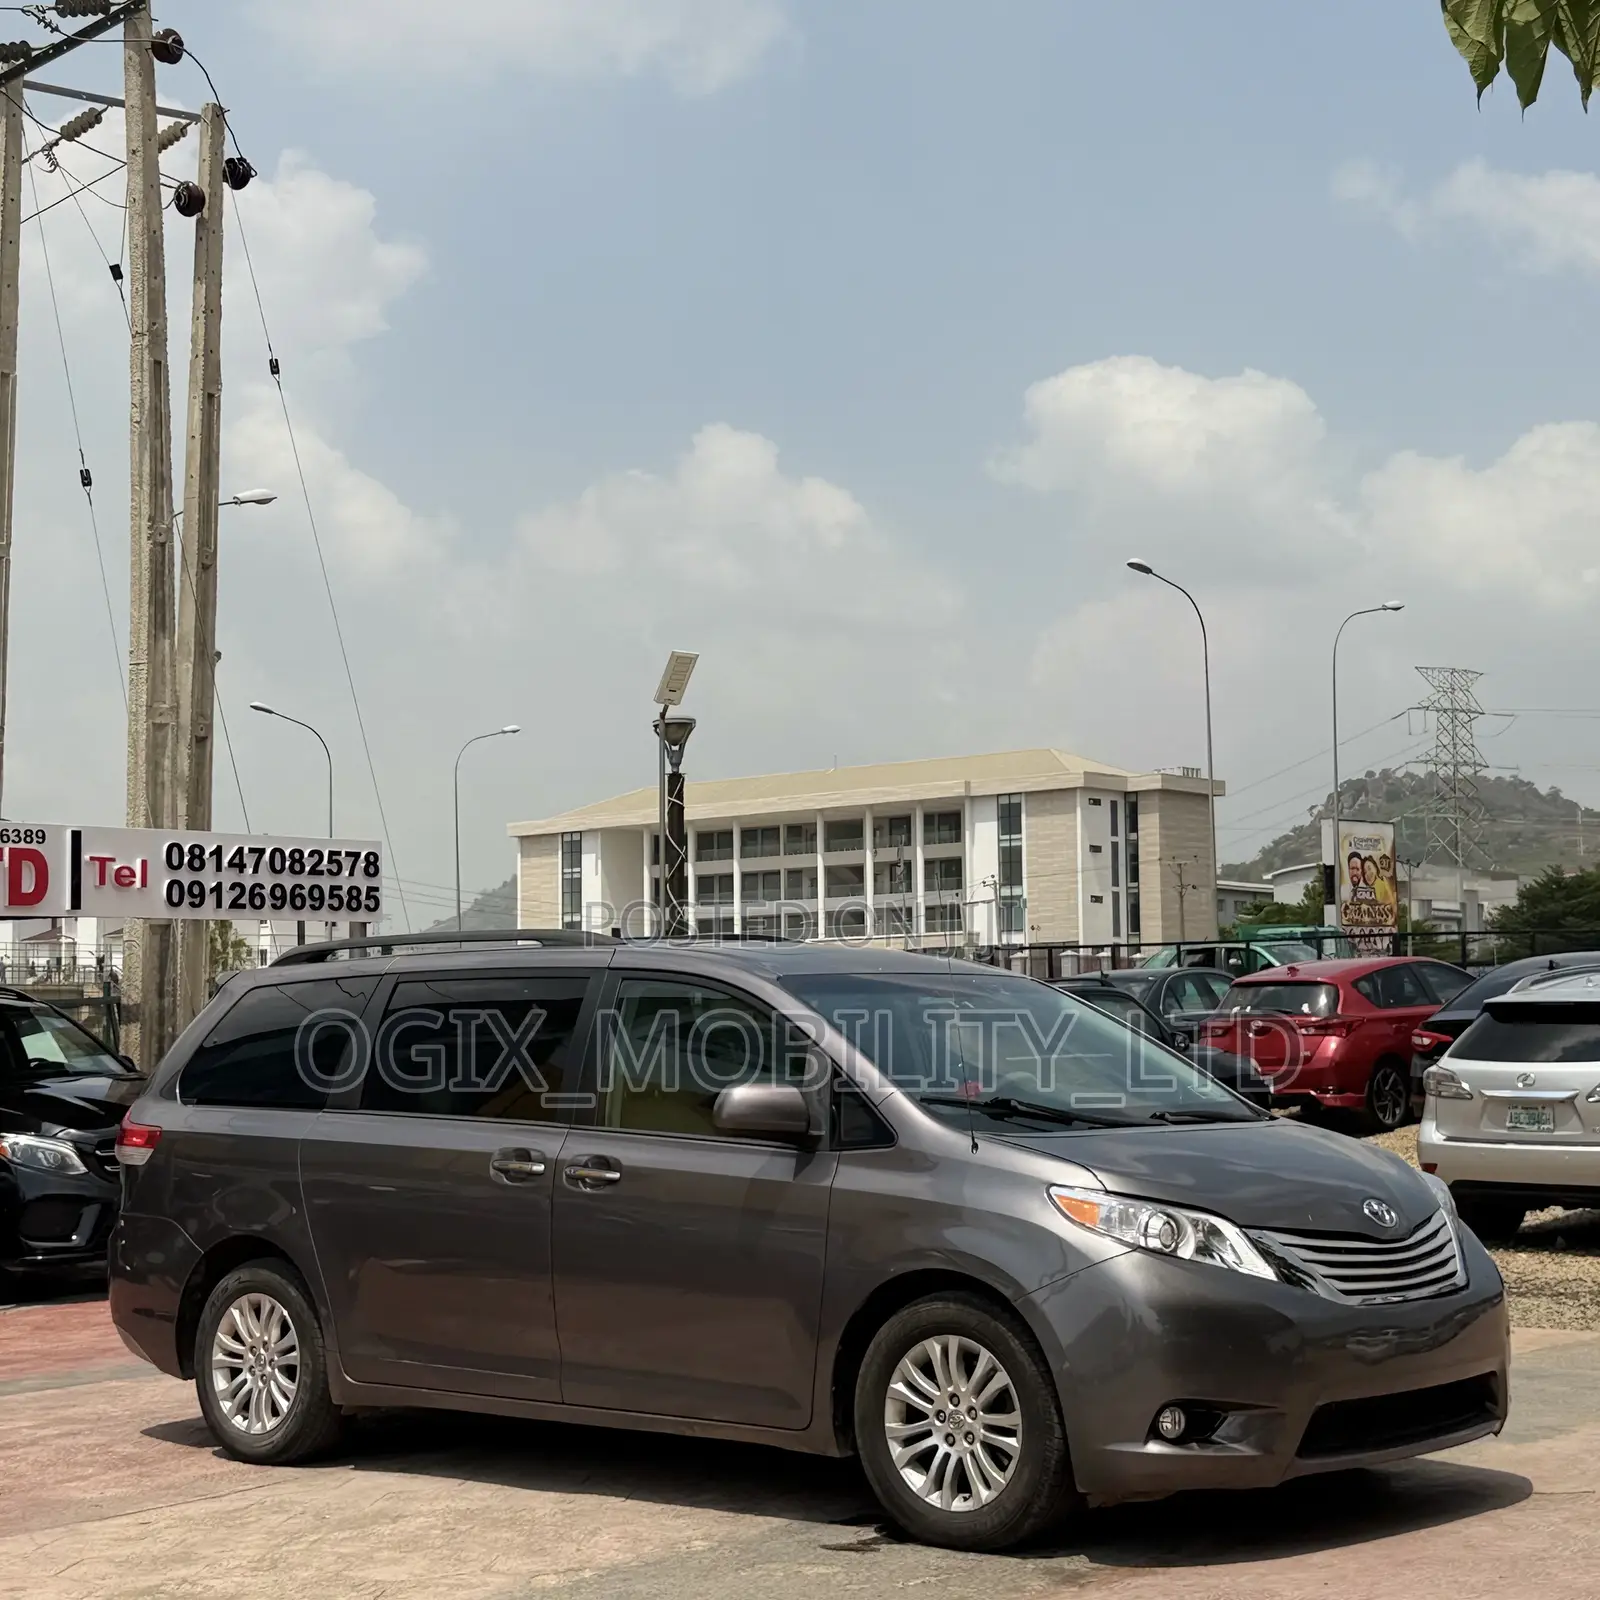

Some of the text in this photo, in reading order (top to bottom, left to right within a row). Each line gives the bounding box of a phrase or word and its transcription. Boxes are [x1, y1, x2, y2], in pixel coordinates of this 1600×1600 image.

[0, 847, 49, 906] D
[87, 856, 148, 888] Tel
[165, 842, 380, 878] 08147082578
[165, 879, 380, 912] 09126969585
